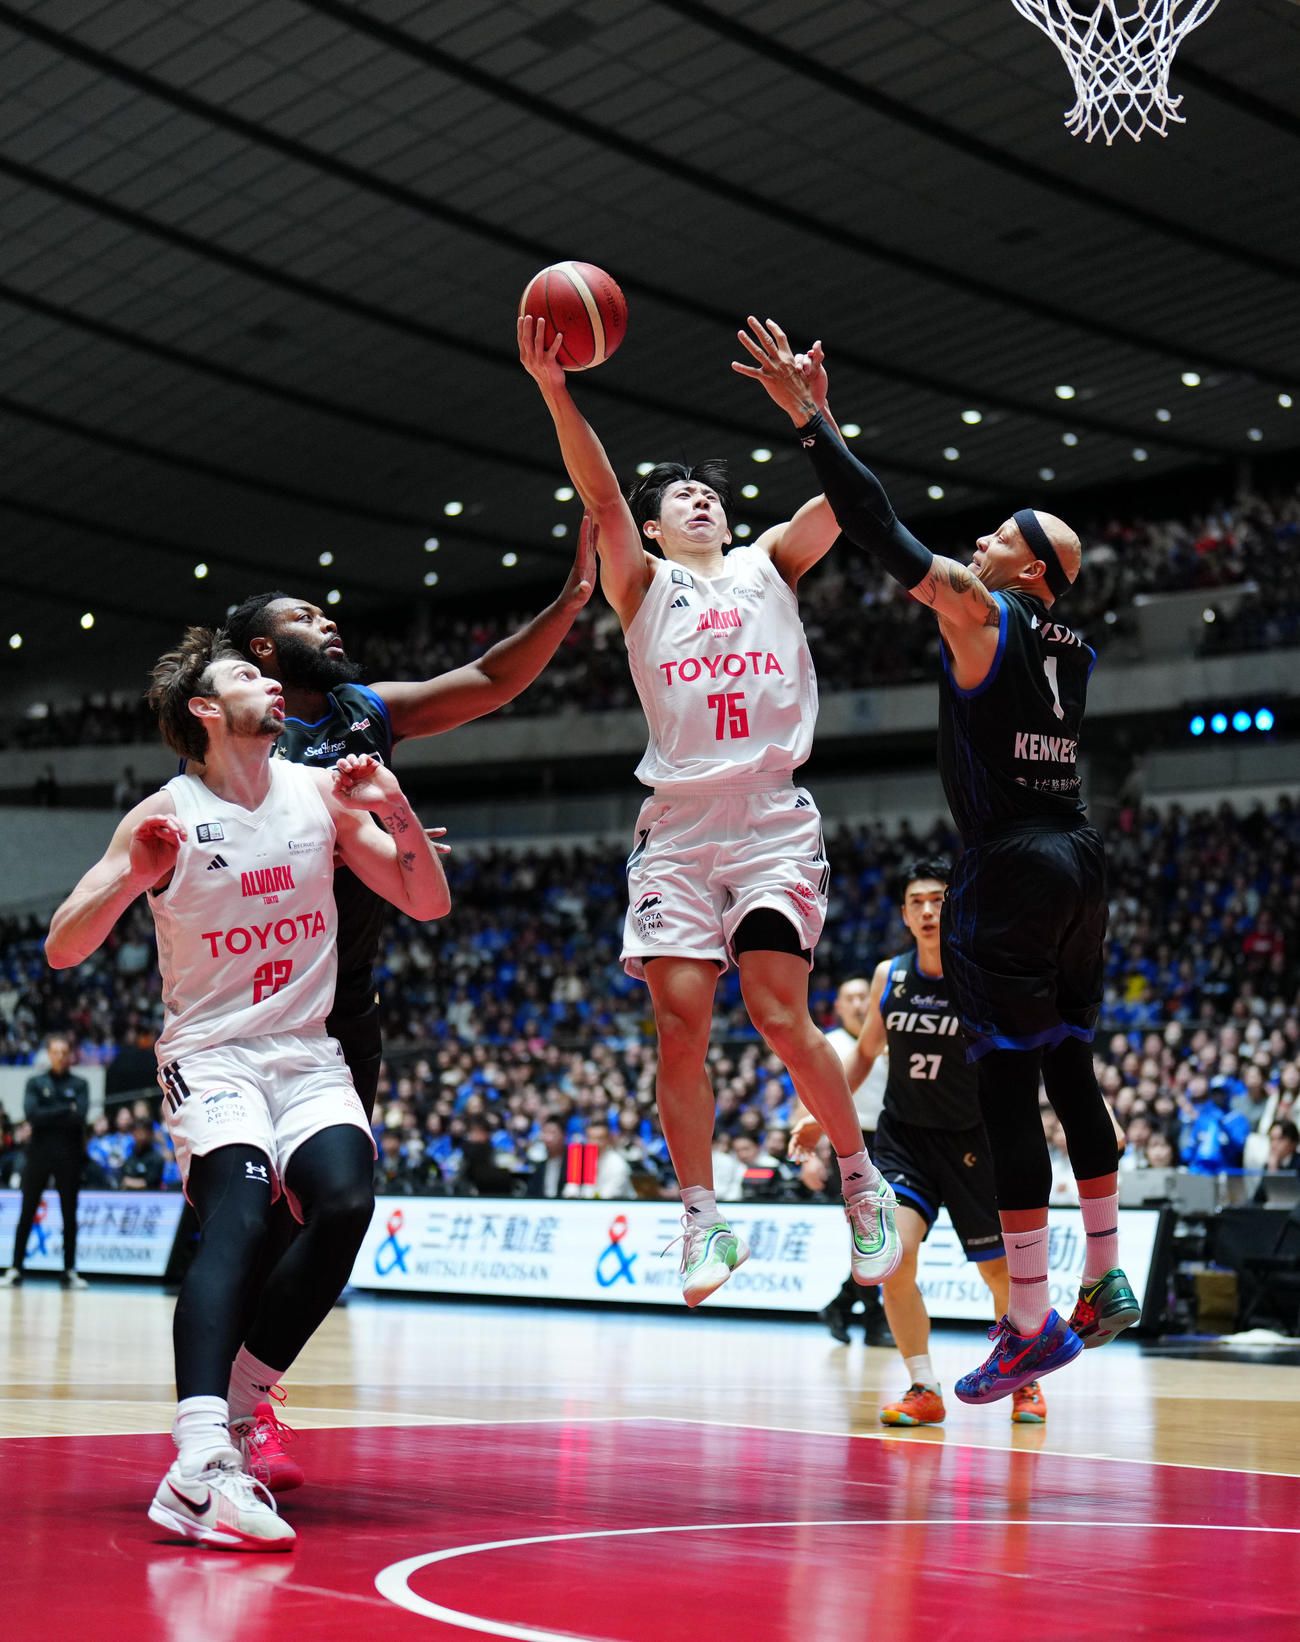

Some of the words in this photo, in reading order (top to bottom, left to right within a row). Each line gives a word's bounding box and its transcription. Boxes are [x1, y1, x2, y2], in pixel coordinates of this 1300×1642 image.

[696, 607, 742, 631] ALVARK
[659, 651, 785, 687] TOYOTA
[1043, 655, 1065, 721] 1
[707, 692, 750, 741] 75
[240, 864, 296, 898] ALVARK
[201, 910, 326, 959] TOYOTA
[637, 912, 663, 927] OYOTA
[909, 1052, 943, 1080] 27
[650, 1218, 816, 1263] 三動産
[724, 1271, 804, 1293] DOSAN
